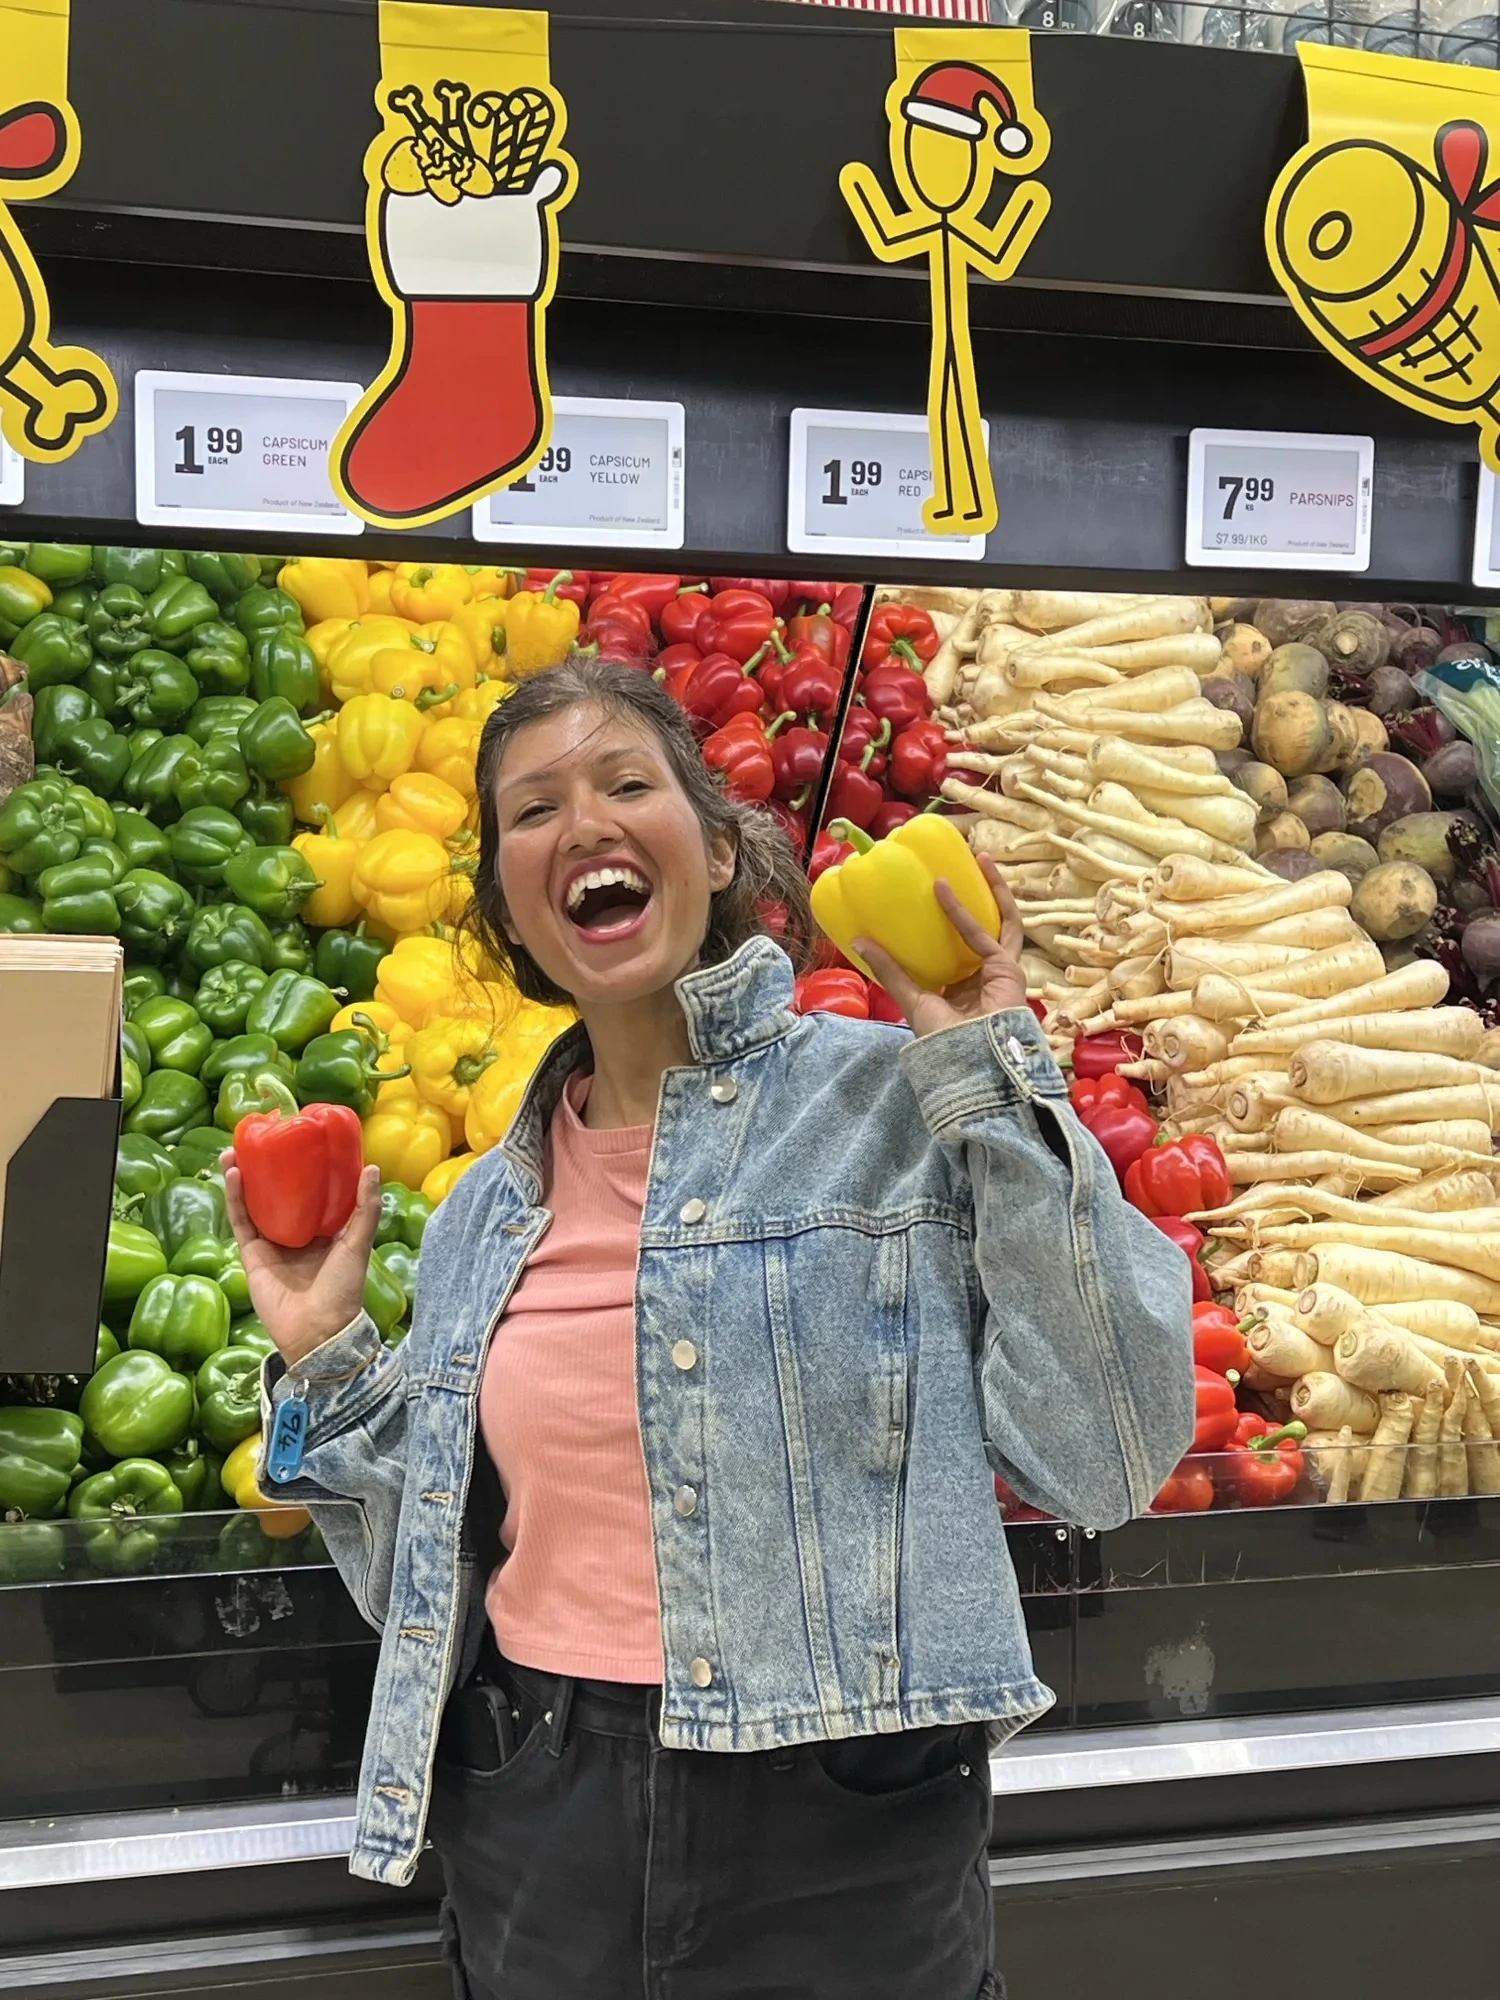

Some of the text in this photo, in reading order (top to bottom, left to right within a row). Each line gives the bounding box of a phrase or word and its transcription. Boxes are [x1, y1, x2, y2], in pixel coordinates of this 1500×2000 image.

[1042, 11, 1055, 28] 8
[1133, 22, 1145, 38] 8
[262, 436, 329, 452] CAPSICUM
[208, 456, 229, 466] EACH
[262, 454, 307, 468] GREEN
[589, 455, 651, 469] CAPSICUM
[539, 475, 558, 483] EACH
[589, 472, 641, 485] YELLOW
[899, 469, 932, 481] CAPSI
[851, 488, 869, 496] EACH
[898, 485, 921, 497] RED
[1289, 492, 1354, 507] PARSNIPS
[1215, 532, 1268, 545] $7.99/1KG
[278, 1414, 301, 1451] 94
